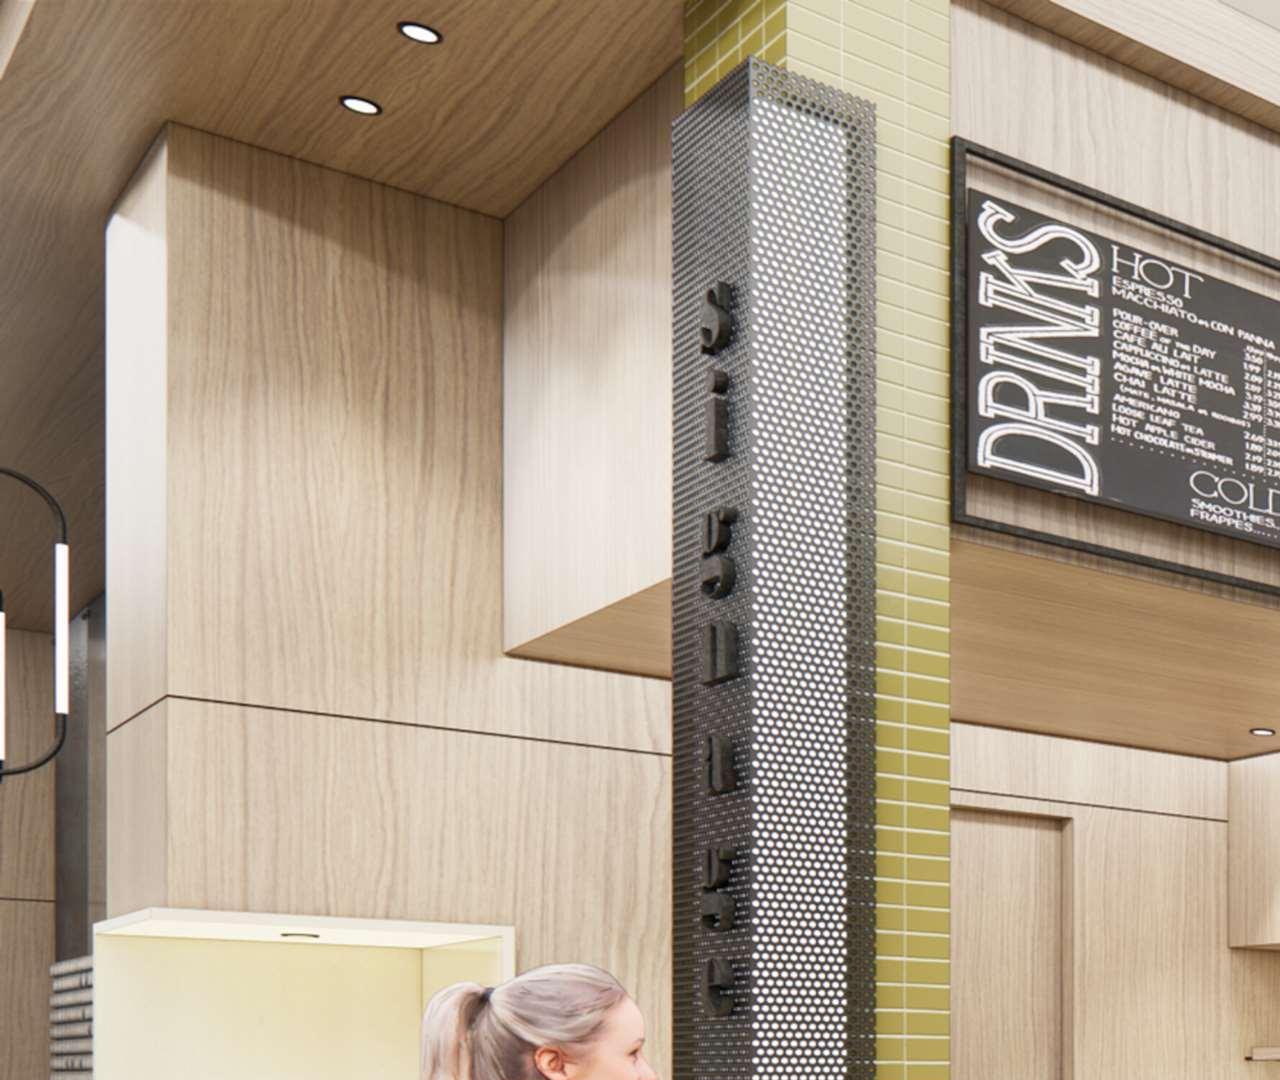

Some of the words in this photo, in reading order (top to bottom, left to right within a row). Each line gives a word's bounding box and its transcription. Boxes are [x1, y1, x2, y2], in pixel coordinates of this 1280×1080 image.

[1111, 245, 1204, 298] HOT
[1112, 275, 1183, 308] ESPRESSO
[1111, 286, 1198, 323] MACCHIATO
[1210, 320, 1235, 336] CON
[1237, 329, 1276, 350] PANNA
[1112, 308, 1179, 337] POUR-OVER
[976, 199, 1101, 497] DRINKS
[1112, 319, 1157, 341] COFFEE
[1192, 344, 1216, 359] DAY
[1151, 341, 1169, 355] AU
[1172, 348, 1200, 364] LAIT
[1112, 349, 1150, 369] MOCHA
[1161, 365, 1195, 383] WHITE
[1198, 377, 1236, 396] MOCHA
[1113, 340, 1181, 368] CAPPUCCINO
[1193, 365, 1228, 384] LATTE
[1113, 361, 1152, 380] AGAVE
[1159, 375, 1197, 394] LATTE
[1113, 371, 1146, 389] CHAI
[1153, 383, 1196, 404] LATTE
[1111, 402, 1145, 420] LOOSE
[1149, 414, 1176, 427] LEAF
[1181, 423, 1204, 436] TEA
[1113, 393, 1181, 419] AMERICANO
[1110, 423, 1132, 437] HOT
[1133, 430, 1186, 452] CHOCOLATE
[1111, 413, 1138, 428] HOT
[1144, 423, 1178, 440] APPLE
[1183, 435, 1215, 450] CIDER
[1190, 508, 1253, 532] FRAPPES
[1191, 498, 1275, 528] SMOOTHIES
